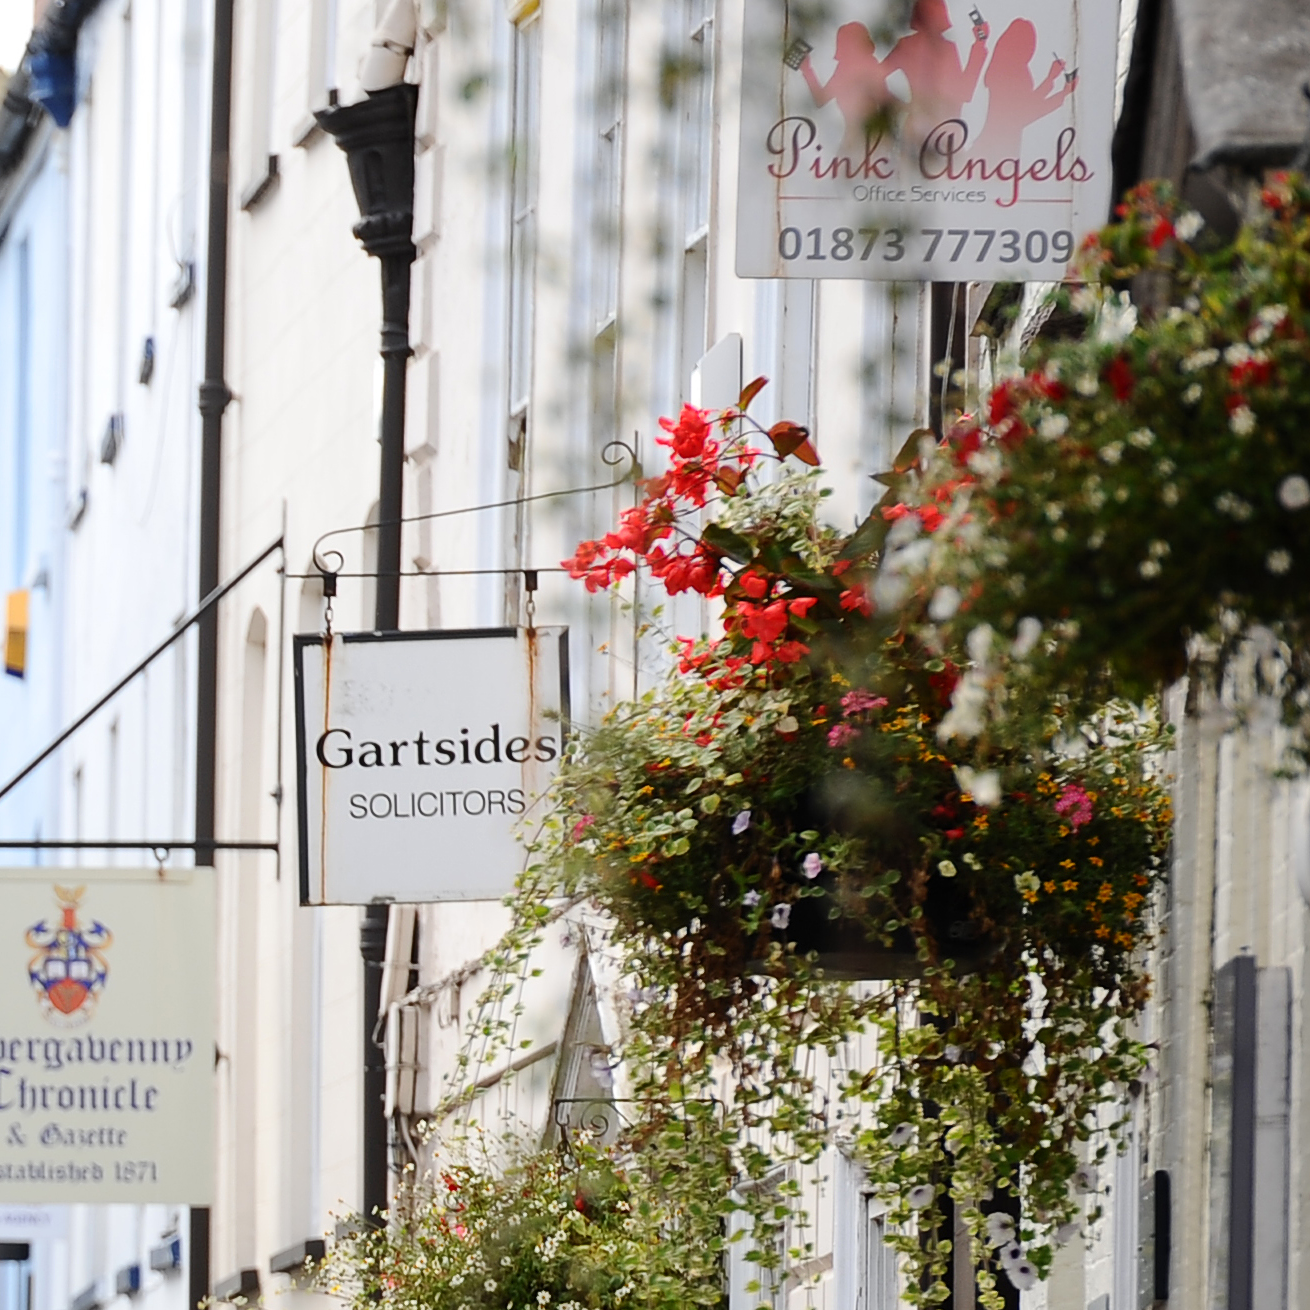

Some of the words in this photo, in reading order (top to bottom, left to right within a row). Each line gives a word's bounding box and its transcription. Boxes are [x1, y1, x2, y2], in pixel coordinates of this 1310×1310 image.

[766, 116, 894, 180] Pink
[919, 118, 1095, 207] Angels
[853, 185, 907, 202] Office
[911, 185, 986, 202] Services
[779, 226, 905, 262] 01873
[920, 228, 1075, 263] 777309
[315, 723, 557, 769] Gartsides
[349, 789, 526, 819] SOLICITORS
[6, 1121, 26, 1147] &
[39, 1121, 128, 1149] Gazette
[114, 1160, 158, 1183] 1871
